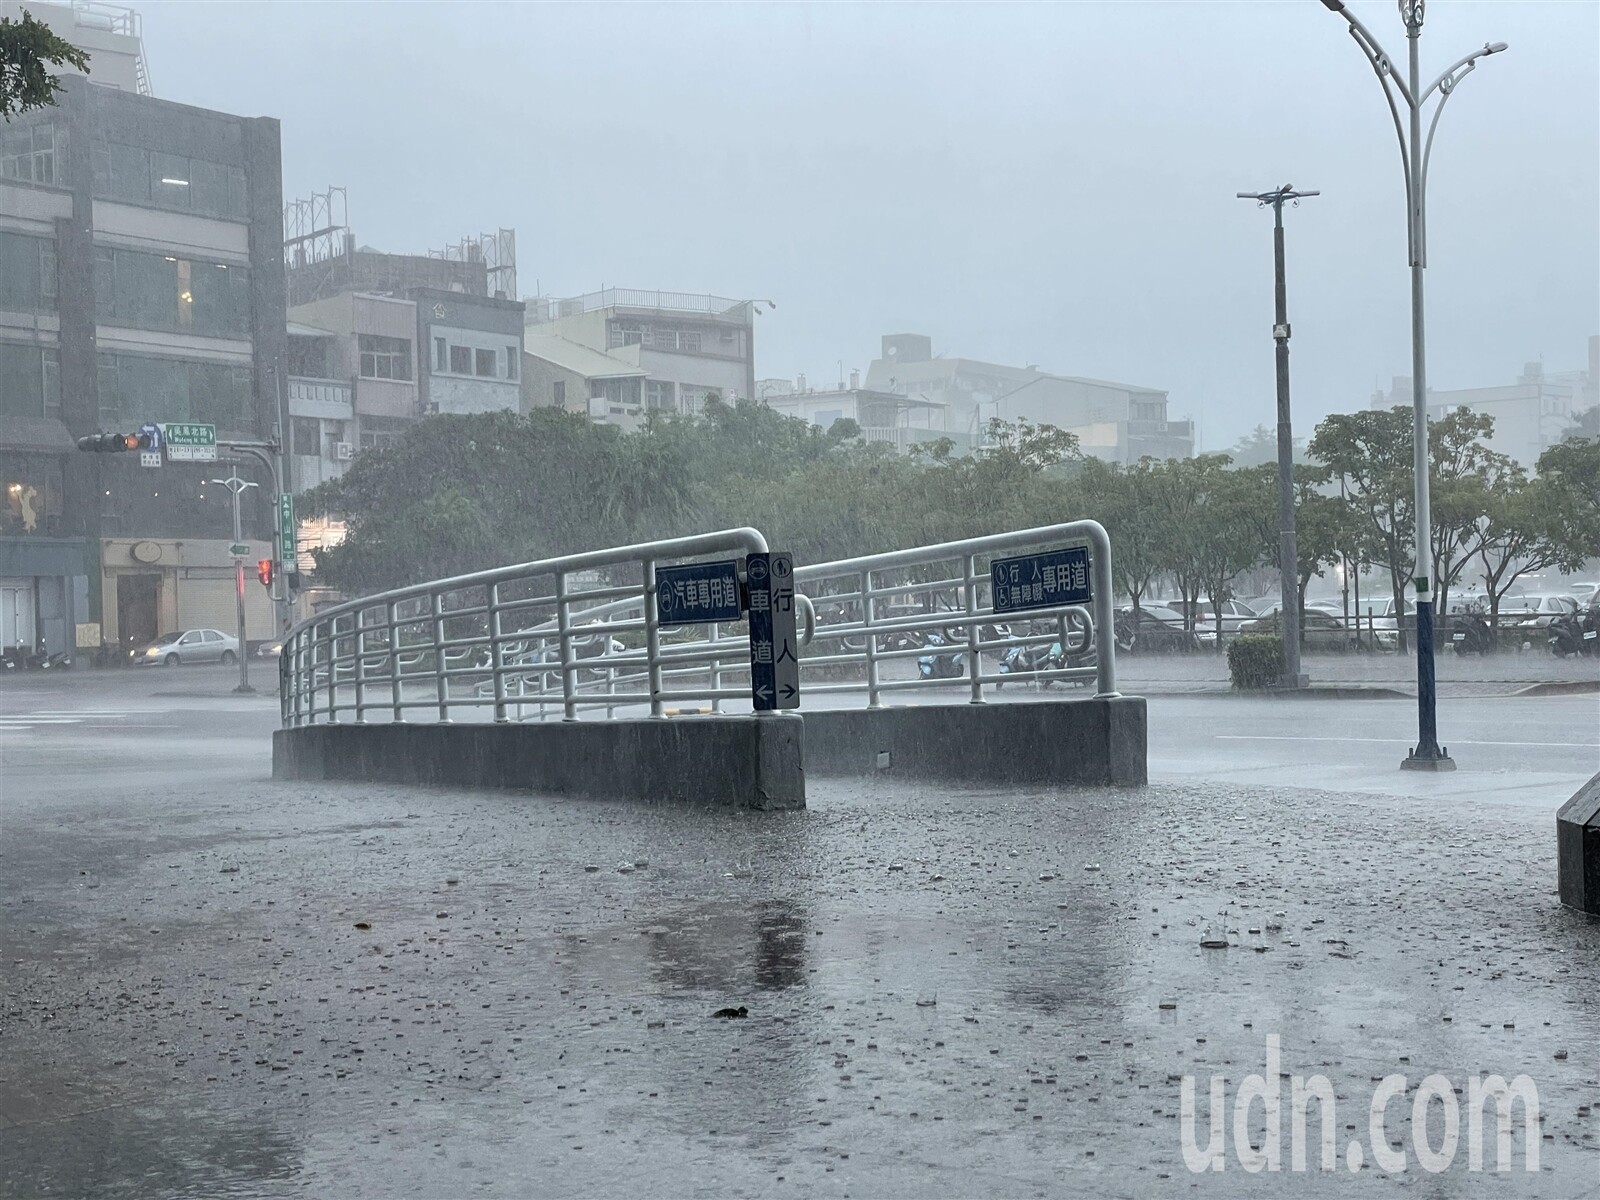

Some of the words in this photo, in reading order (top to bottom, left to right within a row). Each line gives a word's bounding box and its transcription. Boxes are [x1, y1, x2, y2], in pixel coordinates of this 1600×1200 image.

[673, 576, 737, 609] 汽車專用道
[1010, 582, 1044, 605] 無障礙
[1042, 561, 1087, 593] 專用道
[750, 589, 773, 664] 車道
[773, 588, 797, 664] 行人
